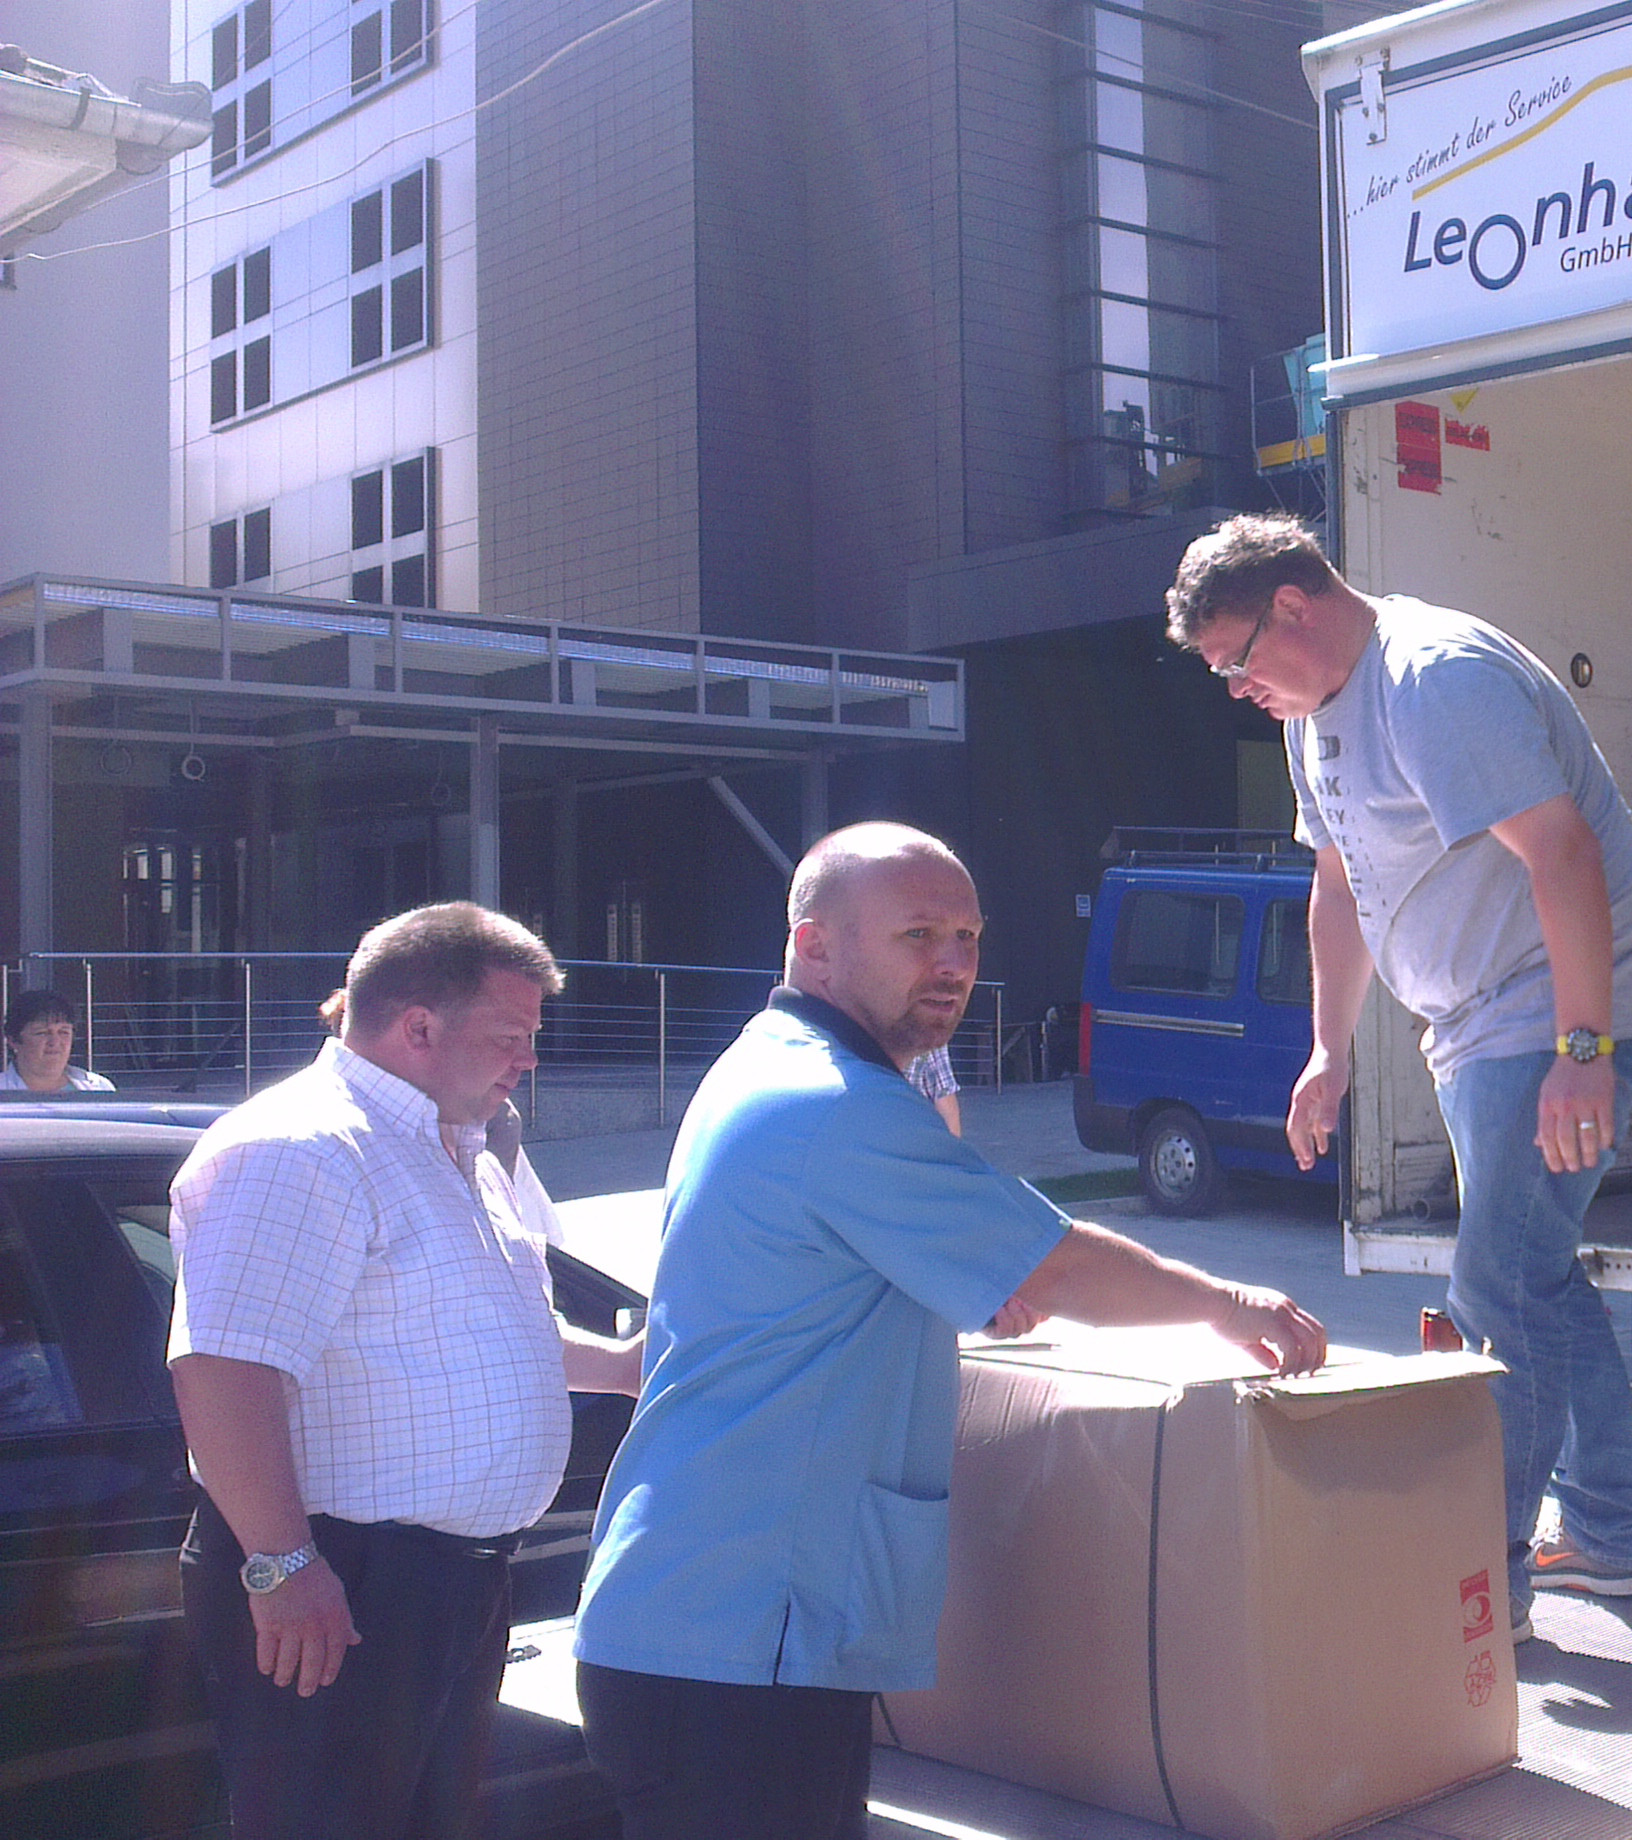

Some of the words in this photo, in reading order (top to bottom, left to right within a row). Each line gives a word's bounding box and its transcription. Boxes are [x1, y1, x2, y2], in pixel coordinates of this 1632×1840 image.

[1406, 133, 1460, 184] stimmt
[1466, 116, 1496, 150] der
[1505, 75, 1573, 128] Service
